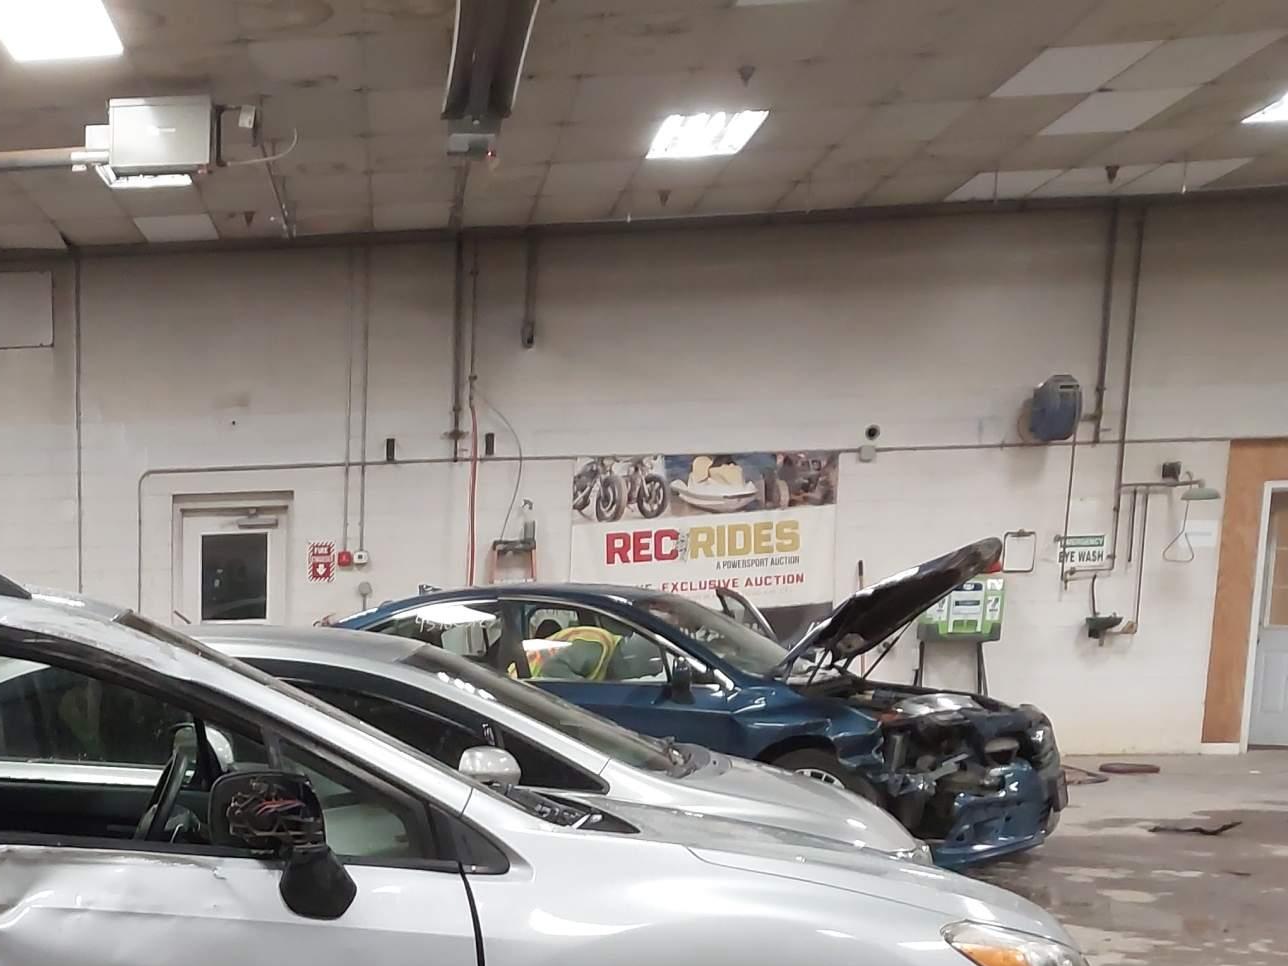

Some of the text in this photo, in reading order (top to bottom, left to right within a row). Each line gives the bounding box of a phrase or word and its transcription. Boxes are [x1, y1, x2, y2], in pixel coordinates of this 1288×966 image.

[606, 529, 679, 565] REC
[688, 520, 801, 560] RIDES
[770, 555, 800, 566] AUCTION
[1058, 550, 1104, 563] EYE WASH
[661, 578, 740, 593] EXCLUSIVE
[744, 573, 804, 587] AUCTION
